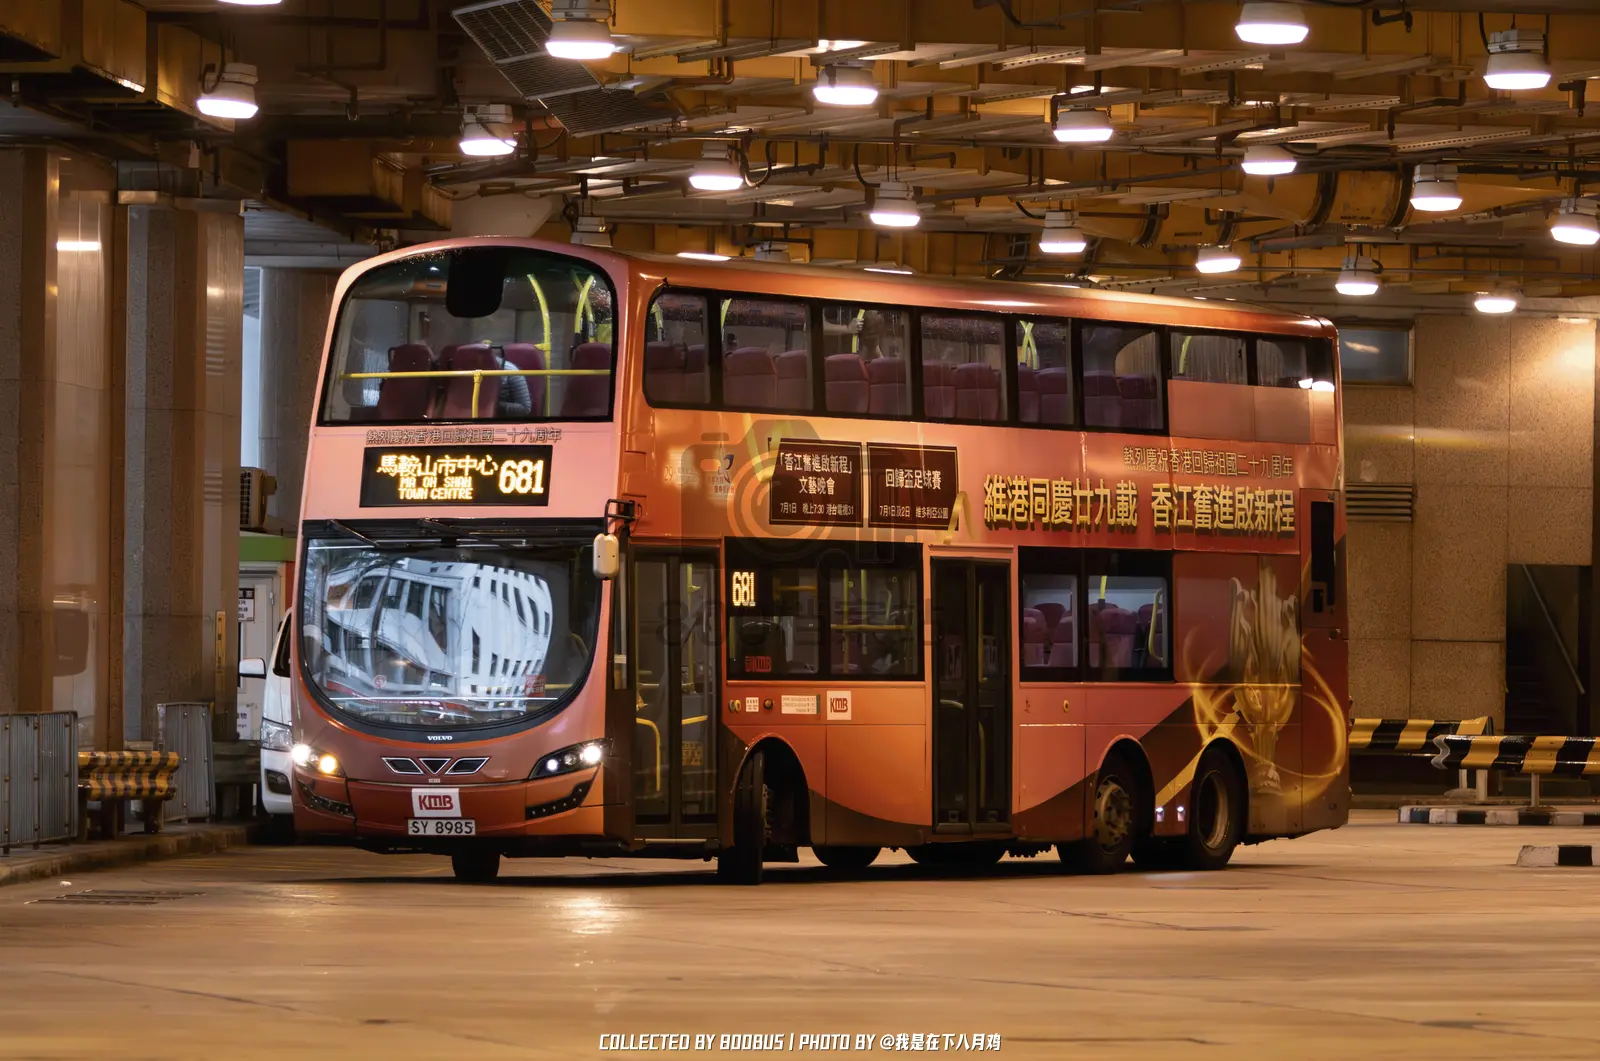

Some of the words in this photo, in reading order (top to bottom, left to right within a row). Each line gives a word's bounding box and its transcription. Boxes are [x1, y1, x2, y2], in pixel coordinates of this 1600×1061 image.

[376, 454, 499, 477] 馬鞍山市中心
[399, 476, 416, 488] MA
[444, 476, 473, 488] SHAN
[499, 459, 545, 494] 681
[885, 468, 942, 491] 回歸盃足球賽
[398, 488, 428, 500] TOWN
[430, 487, 474, 500] CENTRE
[799, 476, 836, 496] 文藝晚會
[780, 502, 797, 514] 7月1日
[983, 474, 1138, 531] 維港同慶廿九載
[1151, 482, 1296, 533] 香江奮進啟新程
[732, 571, 756, 607] 681
[830, 697, 848, 713] KMB
[418, 795, 454, 811] KMB
[411, 821, 428, 834] SY
[435, 821, 473, 834] 8985
